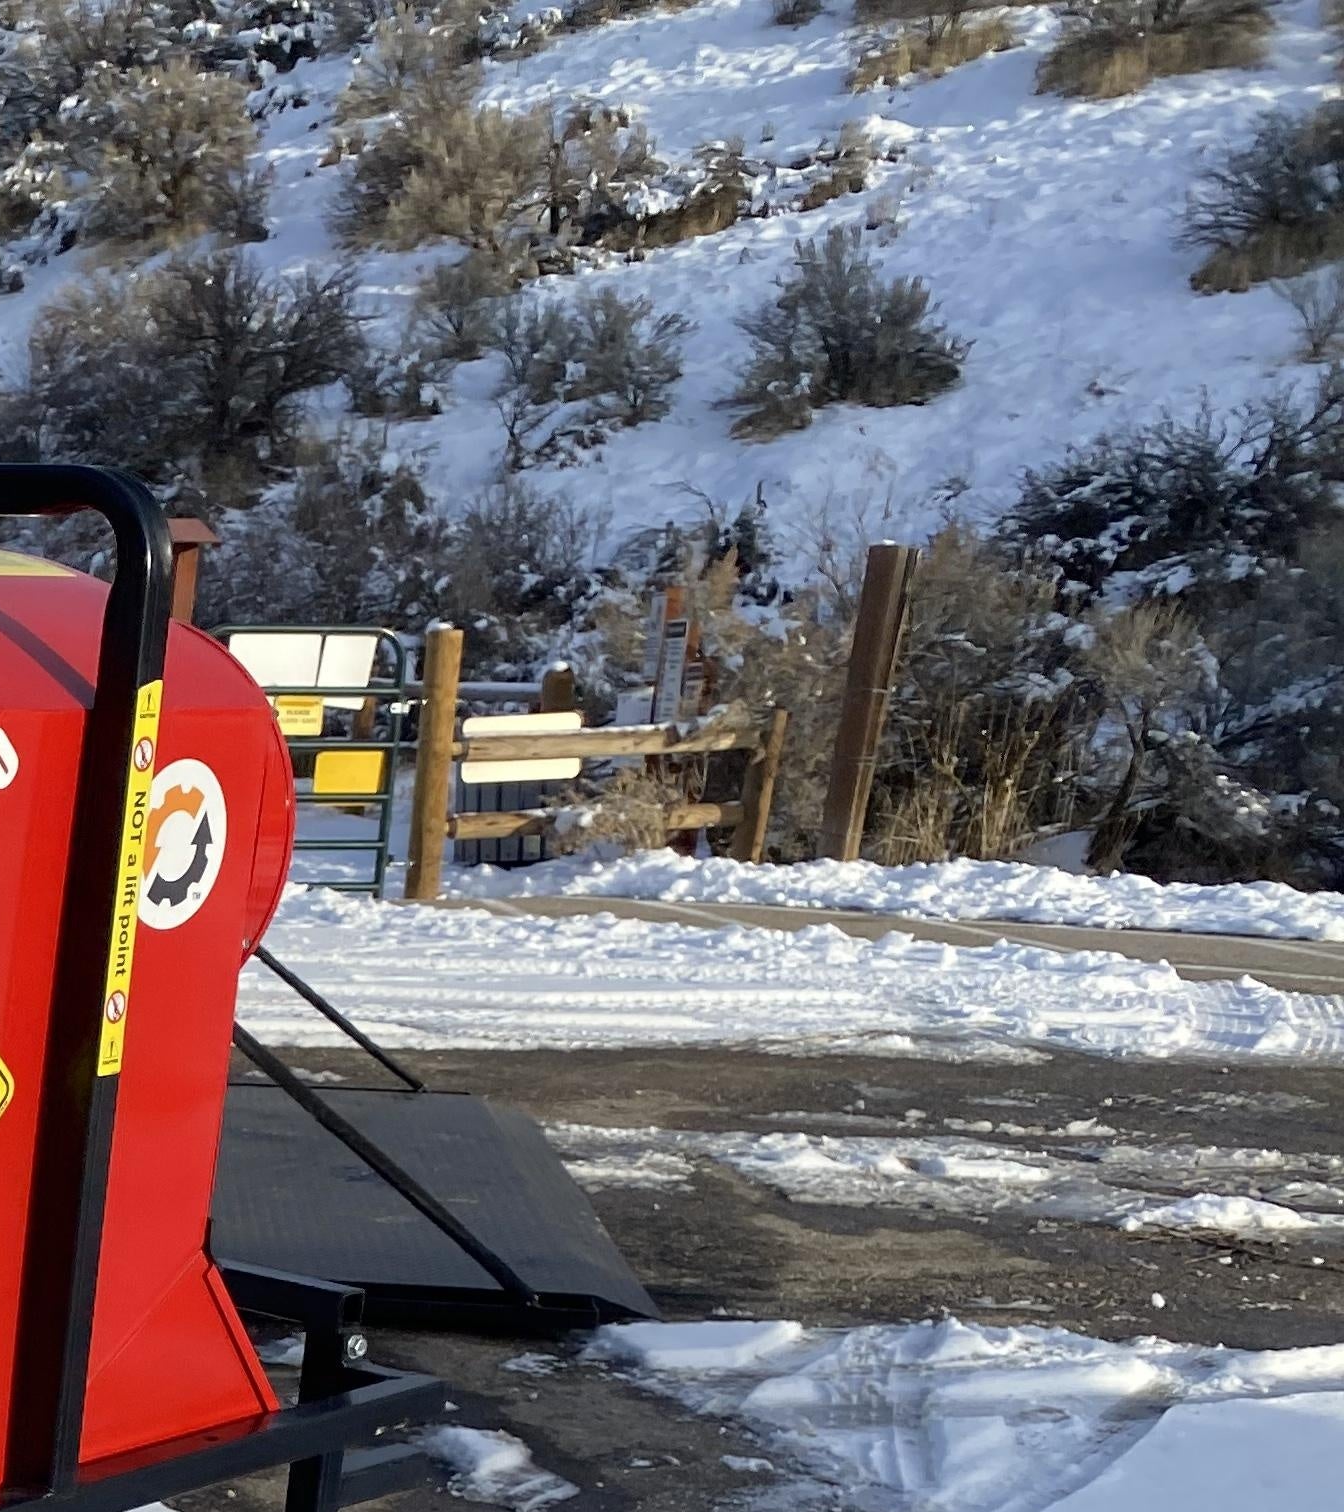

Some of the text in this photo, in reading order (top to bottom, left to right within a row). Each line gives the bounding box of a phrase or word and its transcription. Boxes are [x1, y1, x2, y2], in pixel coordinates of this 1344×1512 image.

[115, 791, 148, 978] NOT a lift point
